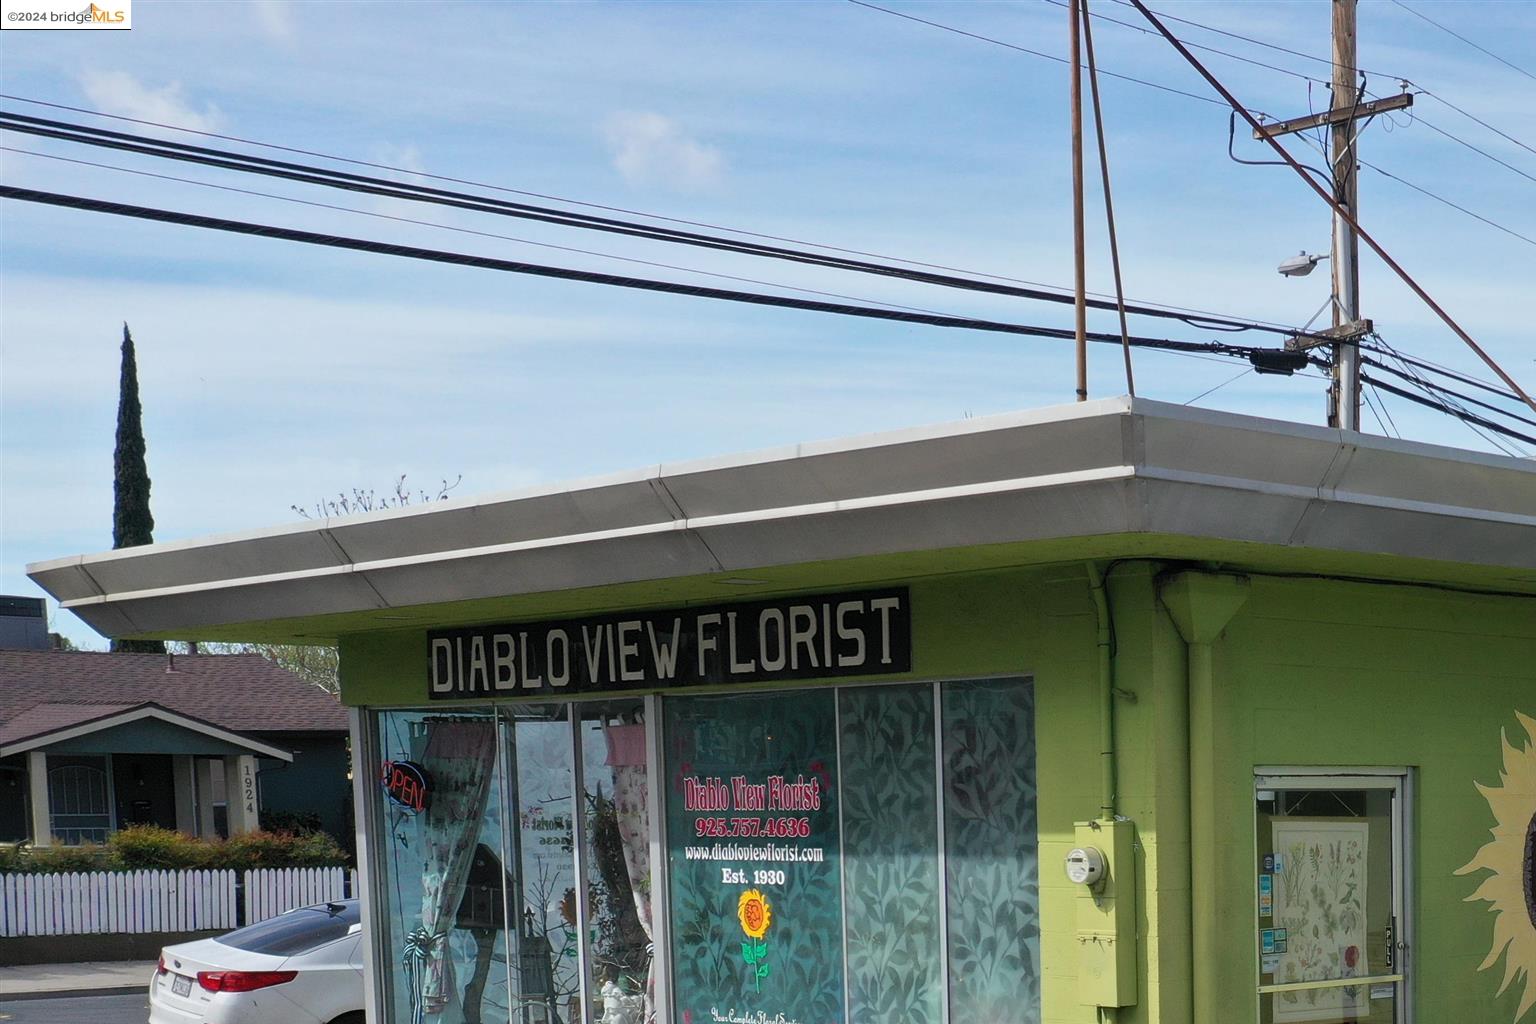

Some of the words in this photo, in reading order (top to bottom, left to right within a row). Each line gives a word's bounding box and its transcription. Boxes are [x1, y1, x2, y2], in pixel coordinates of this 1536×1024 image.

[432, 628, 570, 693] DIABLO
[582, 617, 681, 683] VIEW
[697, 597, 900, 676] FLORIST
[244, 765, 253, 813] 1924
[383, 760, 424, 811] OPEN
[684, 776, 730, 812] Diablo
[731, 775, 766, 811] View
[768, 774, 821, 812] Florist
[695, 817, 811, 837] 925.757.4636
[685, 843, 824, 862] www.diabloviewflorist.com
[721, 868, 748, 884] Est.
[754, 870, 785, 885] 1930
[710, 1006, 728, 1023] Your
